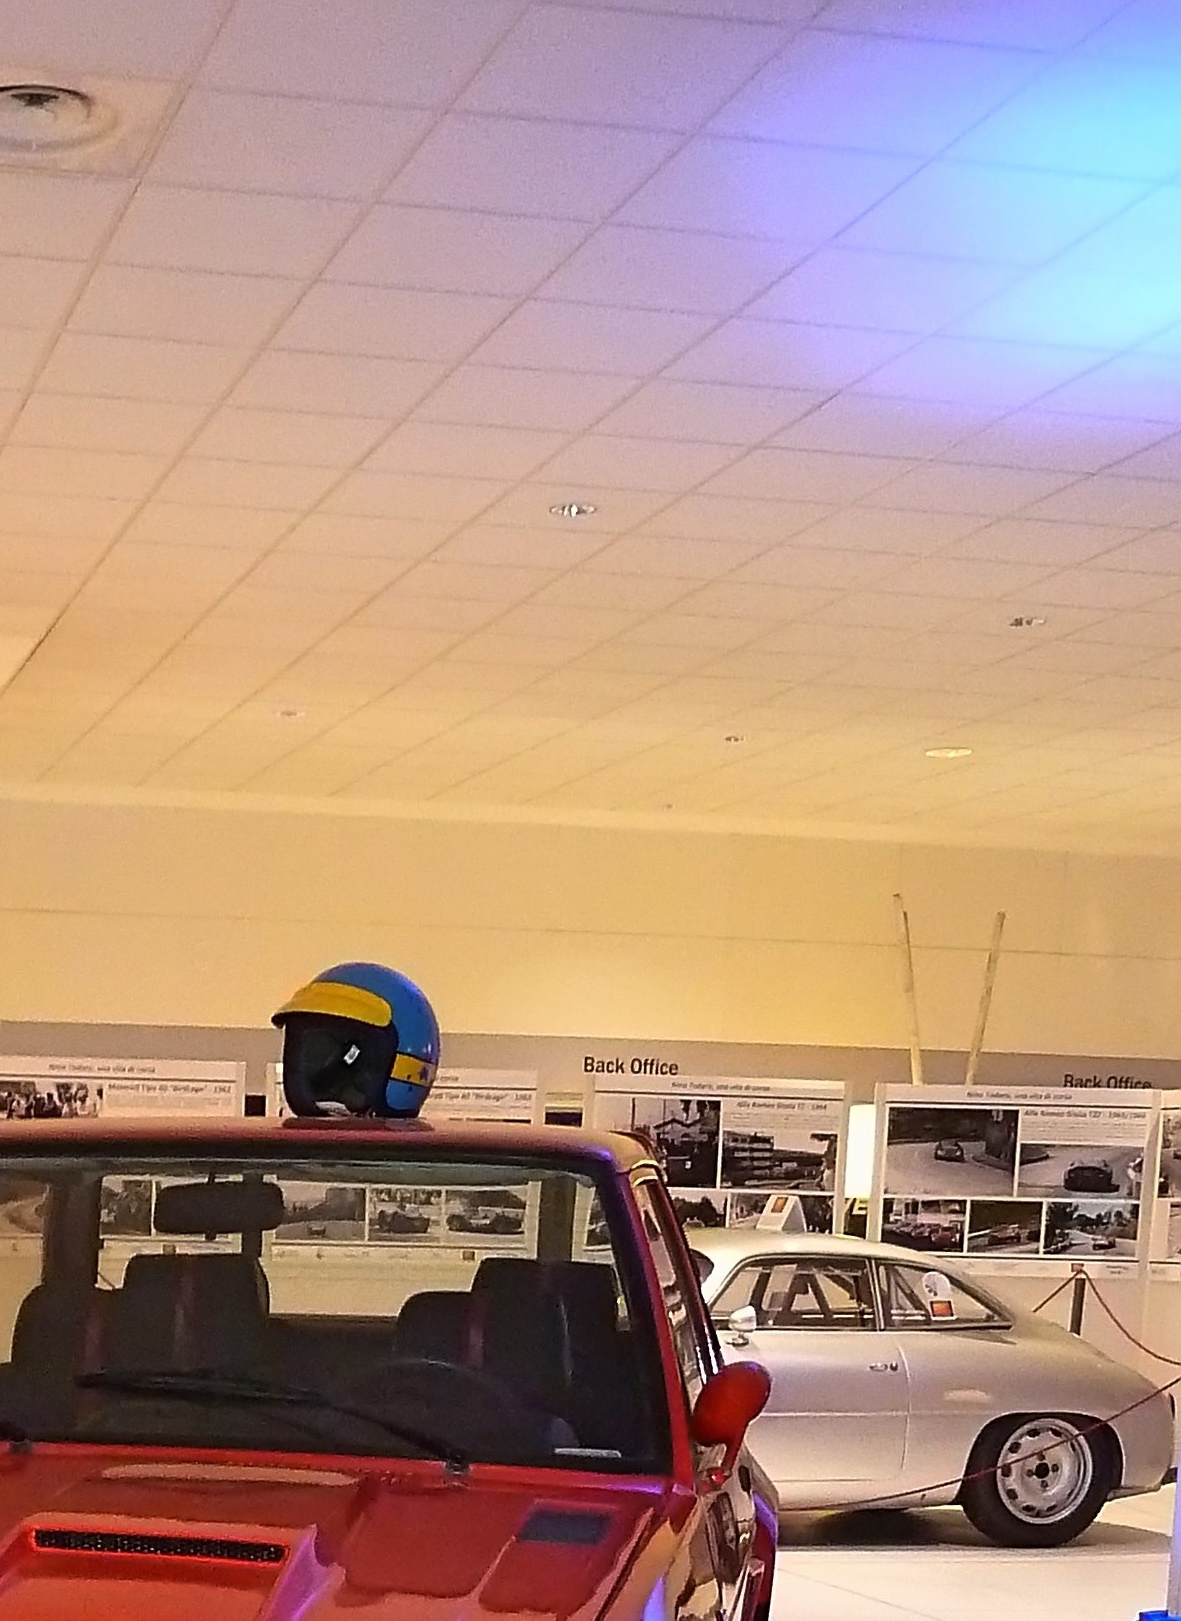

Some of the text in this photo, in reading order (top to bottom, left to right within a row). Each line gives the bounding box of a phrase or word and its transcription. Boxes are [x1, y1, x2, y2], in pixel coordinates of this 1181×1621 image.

[583, 1056, 679, 1076] Back Office
[1063, 1073, 1152, 1090] Back Office
